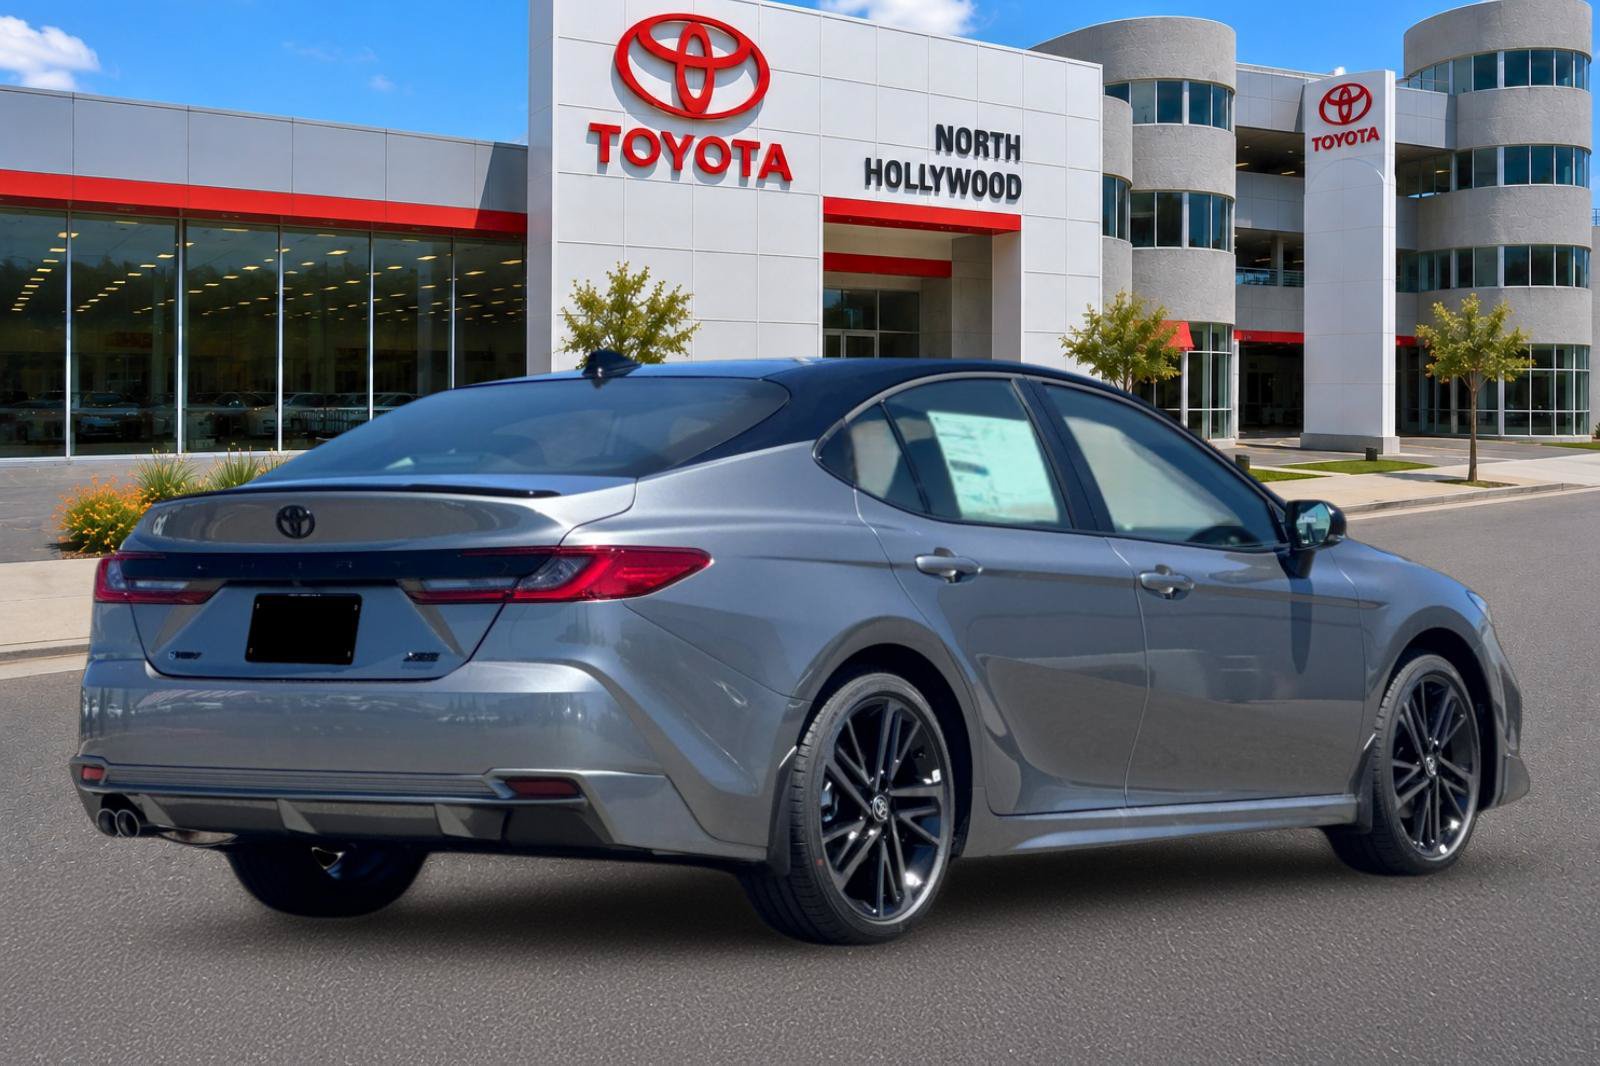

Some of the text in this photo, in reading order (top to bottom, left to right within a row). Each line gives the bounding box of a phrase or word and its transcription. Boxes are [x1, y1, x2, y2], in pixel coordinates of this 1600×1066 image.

[589, 122, 793, 182] TOYOTA
[935, 124, 1021, 161] NORTH
[1312, 126, 1380, 151] TOYOTA
[865, 157, 1021, 200] HOLLYWOOD
